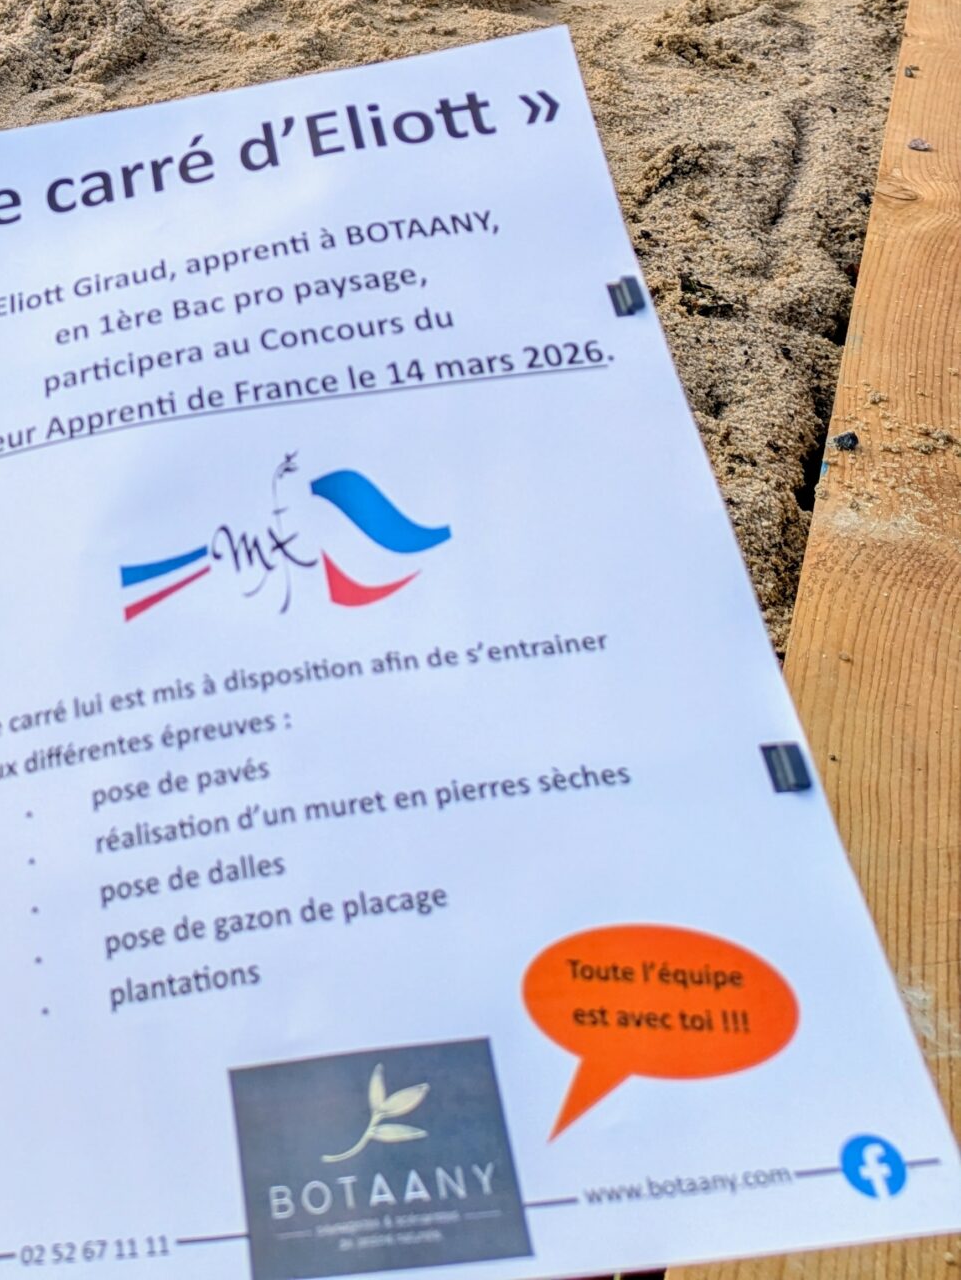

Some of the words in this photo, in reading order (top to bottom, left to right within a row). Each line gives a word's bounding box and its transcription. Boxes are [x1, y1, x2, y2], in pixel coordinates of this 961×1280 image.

[47, 135, 214, 213] carré
[240, 92, 496, 171] d’Eliott
[74, 259, 175, 297] Giraud,
[187, 232, 309, 275] apprenti
[321, 229, 335, 249] à
[346, 210, 499, 246] BOTAANY,
[56, 325, 88, 344] en
[101, 309, 162, 335] 1ère
[173, 298, 223, 320] Bac
[235, 287, 283, 314] pro
[295, 269, 426, 304] paysage,
[45, 347, 203, 398] participera
[215, 338, 249, 358] au
[260, 313, 403, 351] Concours
[414, 307, 454, 332] du
[46, 392, 176, 440] Apprenti
[188, 387, 223, 410] de
[235, 375, 337, 404] France
[348, 366, 375, 389] le
[388, 360, 424, 384] 14
[435, 354, 514, 379] mars
[524, 341, 614, 369] 2026.
[9, 701, 66, 732] carré
[73, 693, 102, 718] lui
[110, 689, 145, 711] est
[153, 679, 195, 703] mis
[203, 674, 216, 695] à
[224, 659, 363, 692] disposition
[372, 652, 419, 673] afin
[427, 647, 458, 668] de
[466, 635, 606, 664] s’entrainer
[24, 735, 153, 774] différentes
[161, 715, 276, 750] épreuves
[92, 781, 150, 811] pose
[158, 772, 188, 795] de
[197, 758, 270, 793] pavés
[96, 815, 229, 853] réalisation
[238, 805, 296, 830] d’un
[305, 792, 386, 820] muret
[394, 790, 427, 809] en
[436, 778, 530, 810] pierres
[538, 765, 631, 792] sèches
[100, 877, 159, 908] pose
[168, 866, 199, 891] de
[208, 855, 285, 884] dalles
[105, 927, 165, 959] pose
[174, 916, 205, 942] de
[214, 908, 292, 942] gazon
[300, 898, 333, 923] de
[343, 889, 447, 924] placage
[110, 965, 260, 1012] plantations
[567, 959, 634, 982] Toute
[642, 962, 743, 990] l’équipe
[573, 1008, 609, 1026] est
[617, 1011, 671, 1030] avec
[679, 1011, 713, 1031] toi
[722, 1011, 749, 1033] !!!
[268, 1162, 495, 1220] BOTAANY
[585, 1168, 792, 1204] www.botaany.com
[20, 1245, 45, 1266] 02
[52, 1242, 76, 1264] 52
[82, 1240, 107, 1262] 67
[115, 1238, 138, 1260] 11
[146, 1235, 169, 1257] 11
